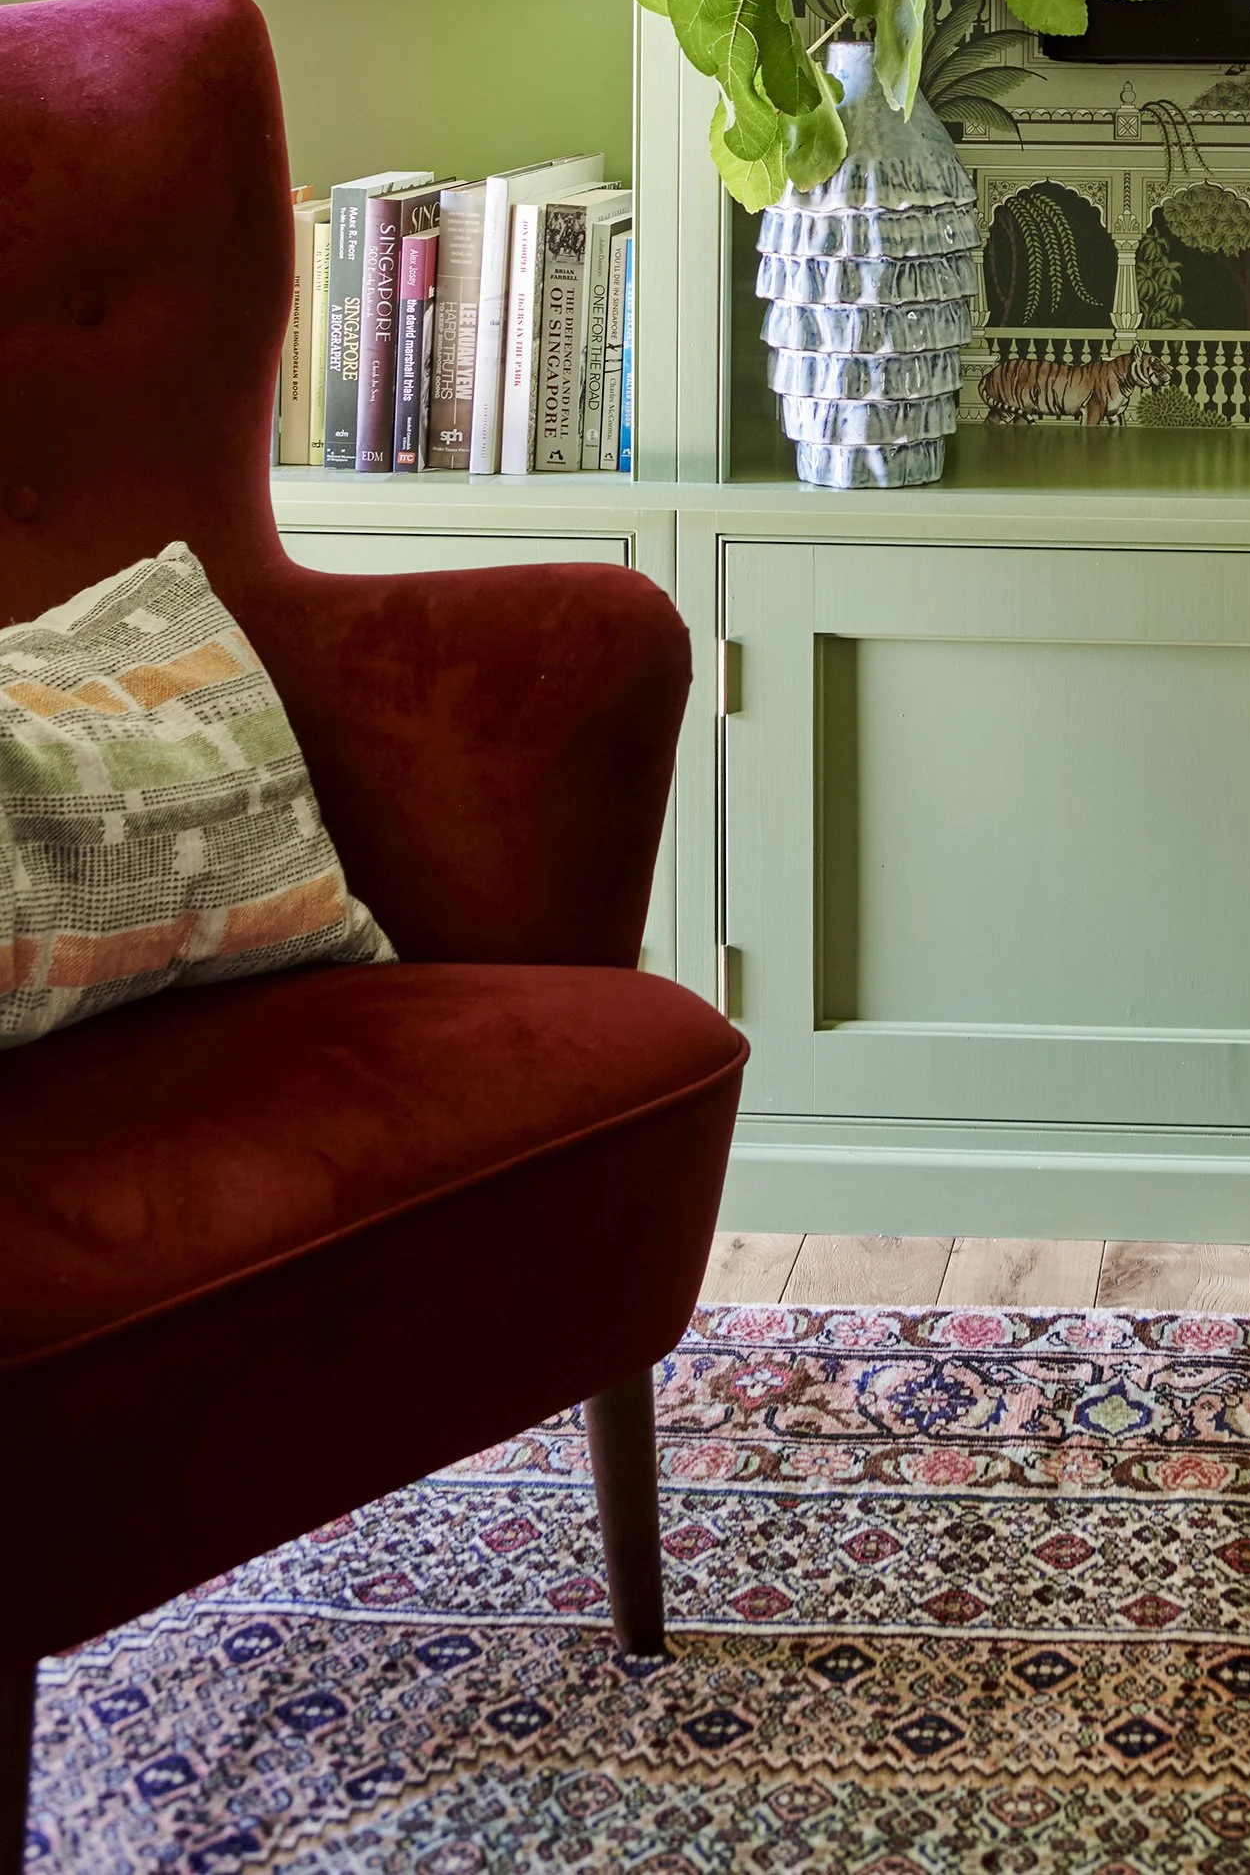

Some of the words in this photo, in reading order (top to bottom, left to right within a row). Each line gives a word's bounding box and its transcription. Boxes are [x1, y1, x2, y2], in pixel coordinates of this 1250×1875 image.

[375, 223, 396, 342] SINGAPORE
[593, 284, 605, 314] ONE
[549, 287, 563, 316] OF
[566, 288, 575, 314] THE
[443, 301, 458, 340] HARD
[591, 316, 604, 343] FOR
[343, 297, 360, 381] SINGAPORE
[563, 317, 573, 374] DEFENCE
[590, 345, 602, 368] THE
[441, 343, 457, 400] TRUTHS
[544, 319, 562, 438] SINGAPORE
[561, 376, 571, 405] AND
[588, 372, 600, 411] ROAD
[560, 408, 570, 439] FALL
